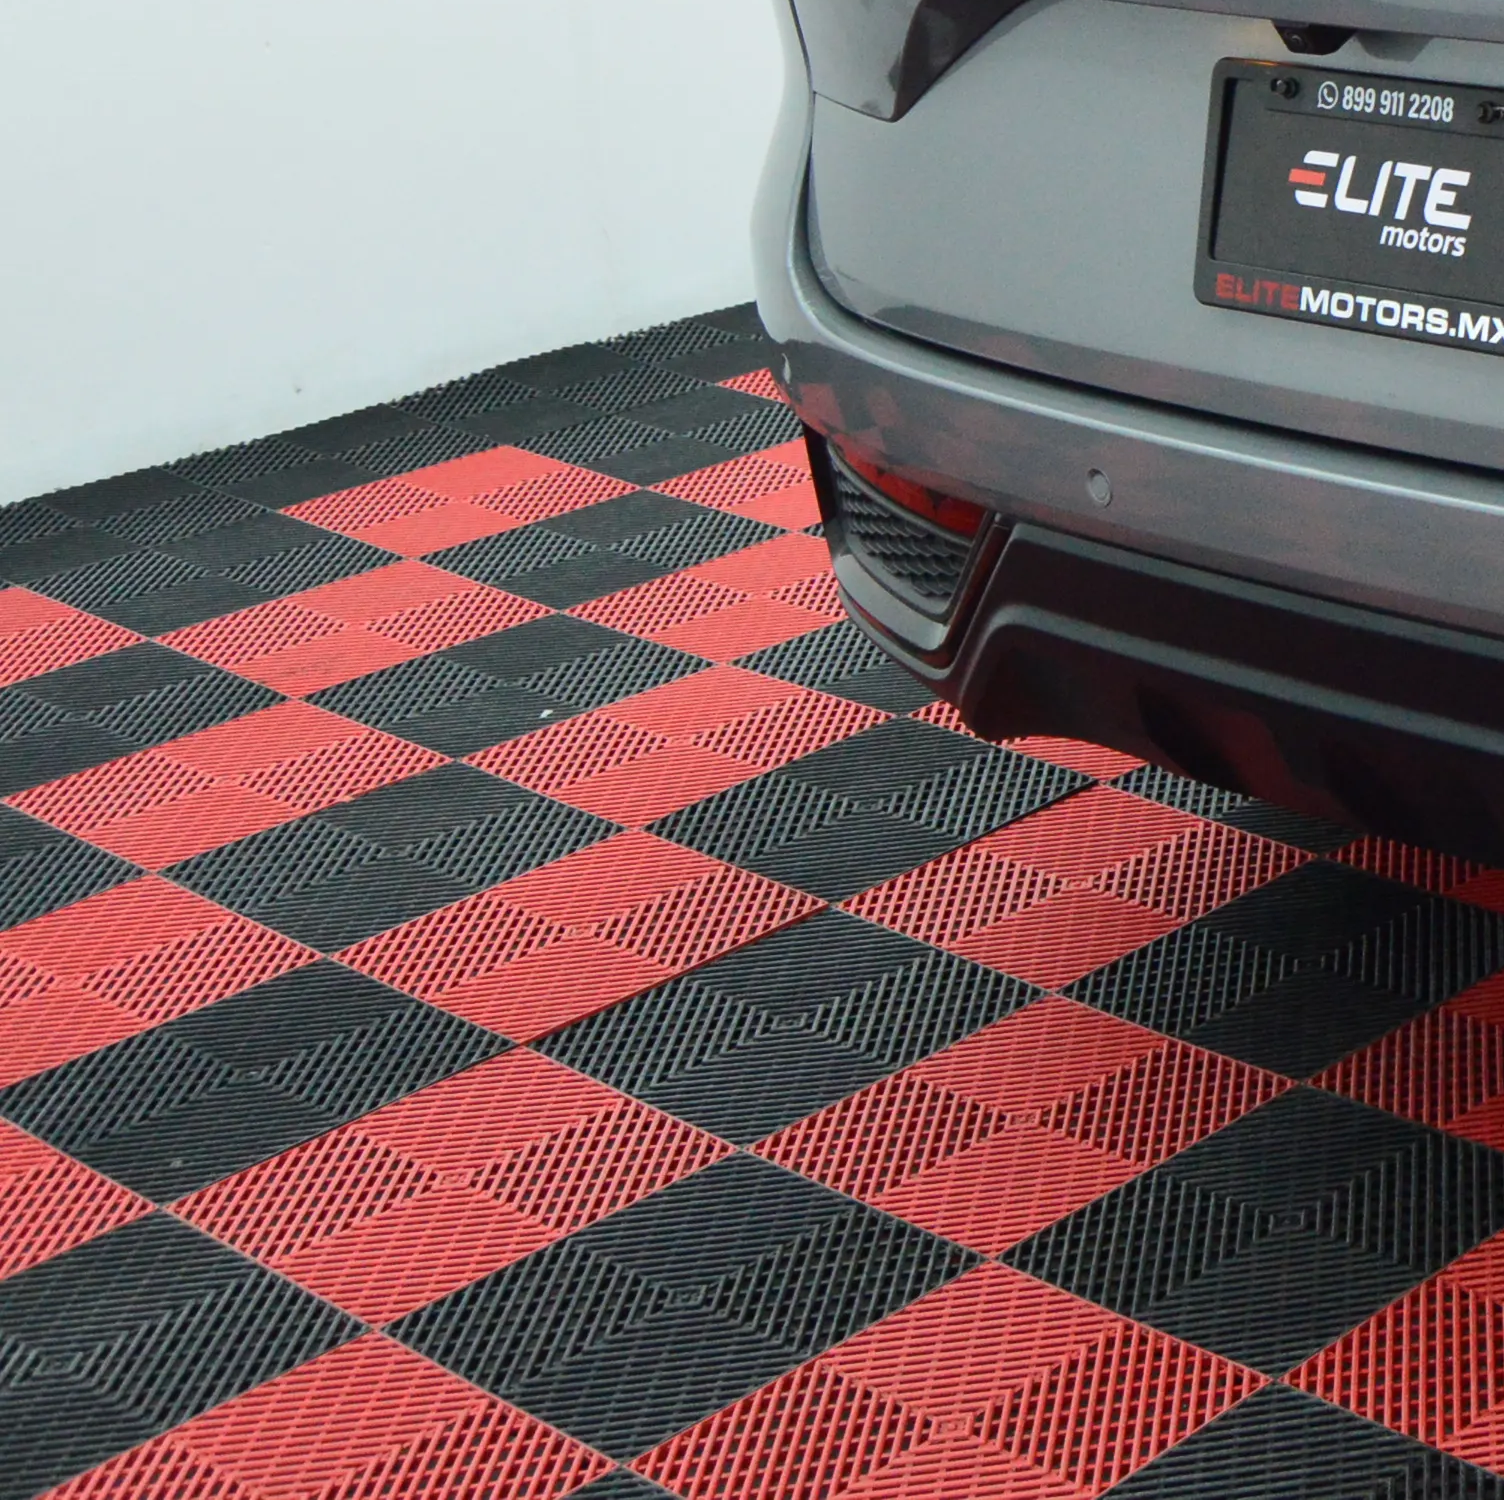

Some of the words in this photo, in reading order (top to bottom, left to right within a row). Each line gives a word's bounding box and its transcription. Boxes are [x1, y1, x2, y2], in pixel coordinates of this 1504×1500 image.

[1342, 85, 1374, 113] 899
[1380, 89, 1404, 117] 911
[1408, 93, 1455, 123] 2208
[1288, 149, 1472, 230] ELITE
[1379, 225, 1467, 258] motors
